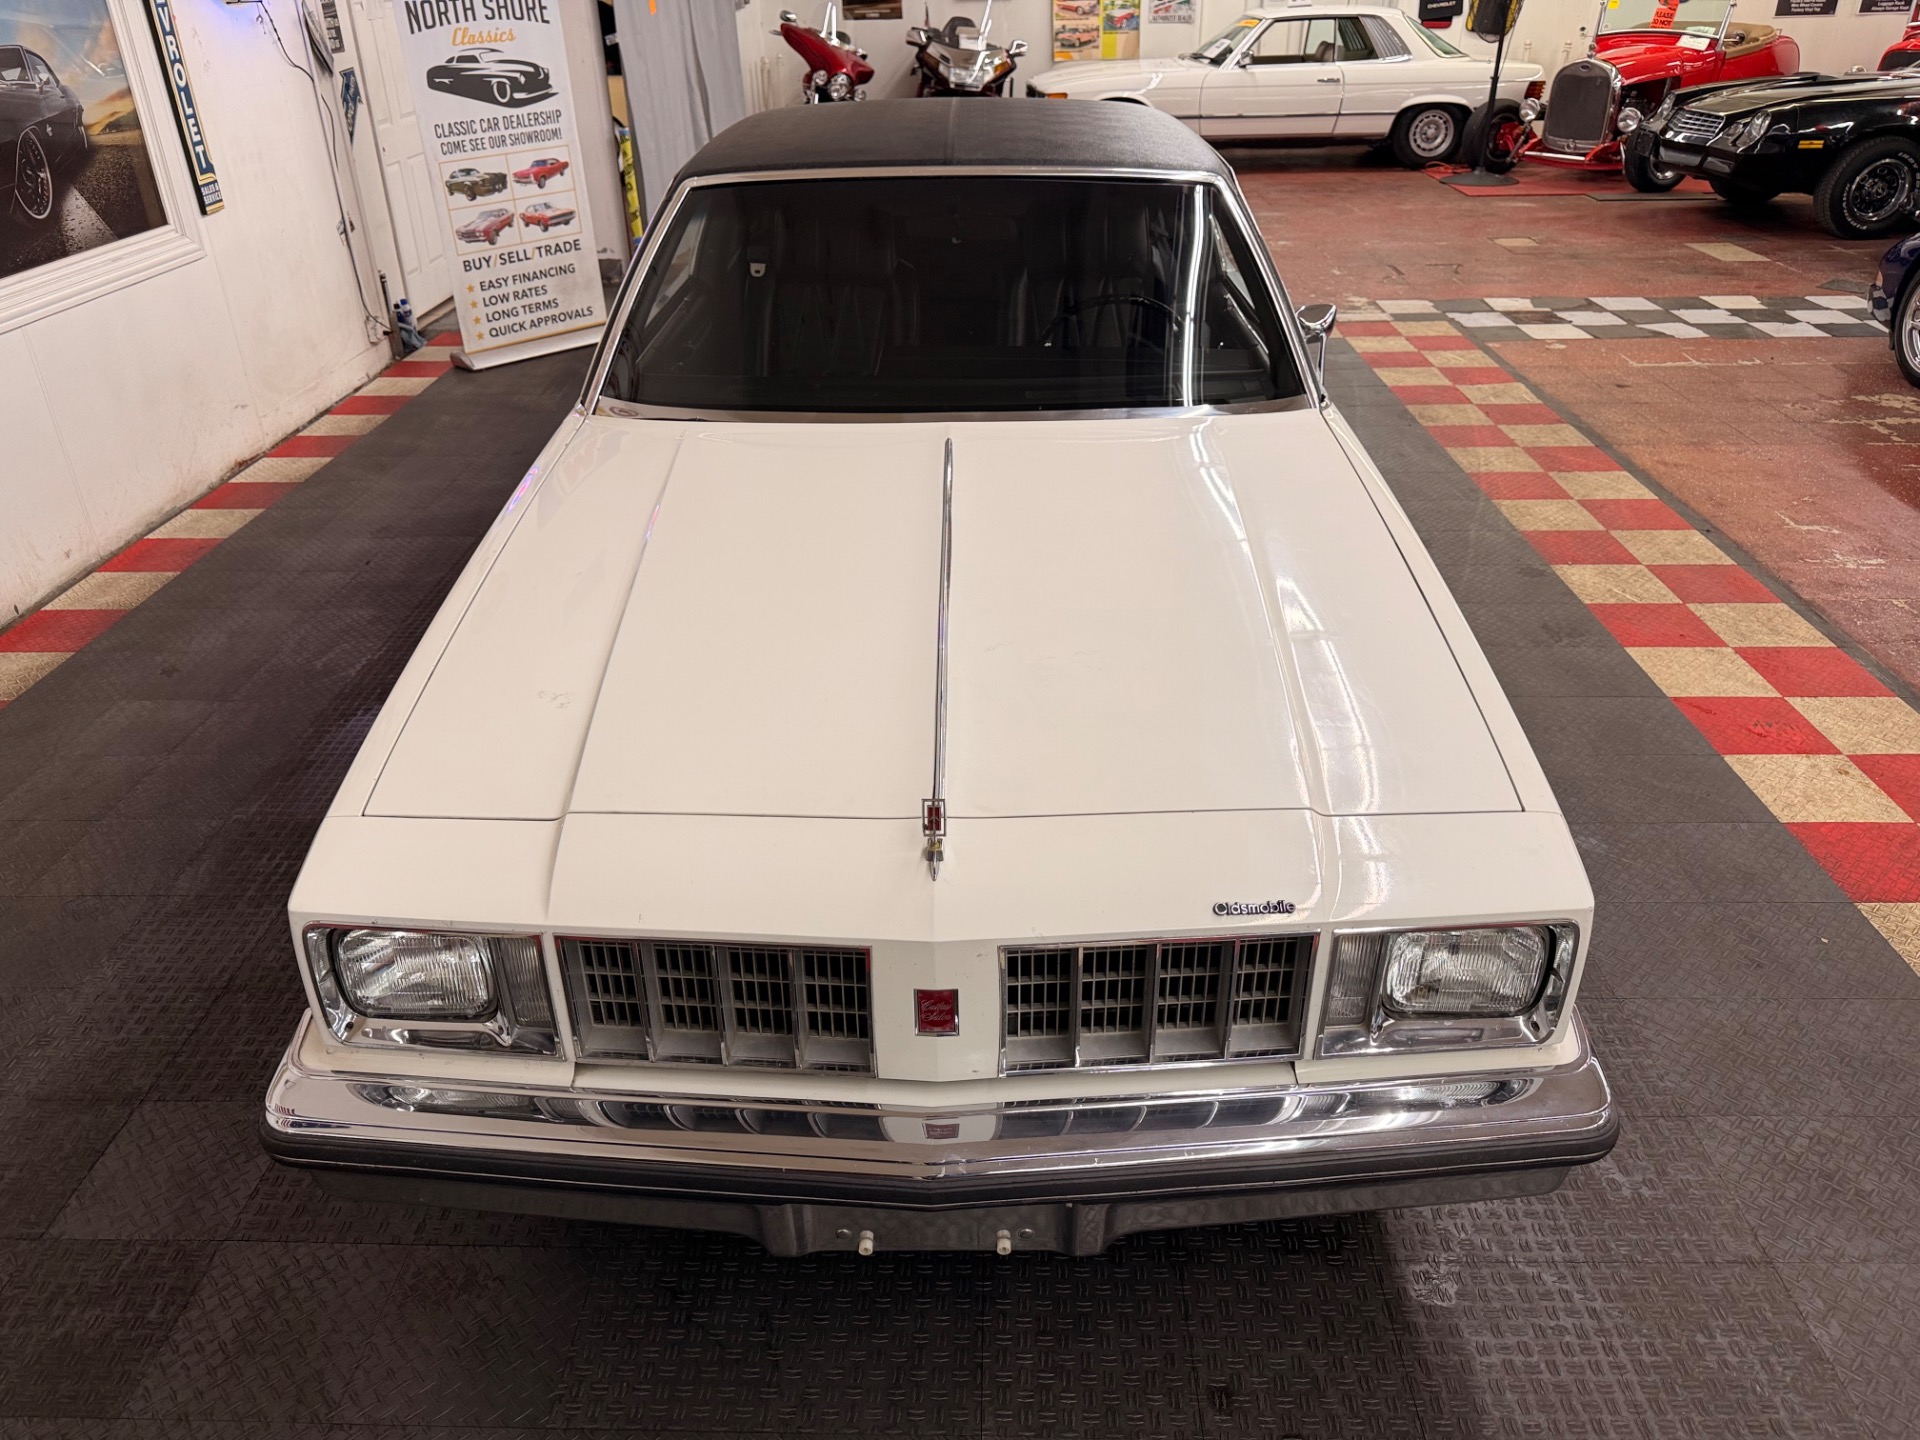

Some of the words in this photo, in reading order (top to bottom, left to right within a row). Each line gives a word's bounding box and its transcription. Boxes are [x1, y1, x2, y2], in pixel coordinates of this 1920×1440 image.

[405, 0, 477, 34] NORTH
[482, 0, 550, 24] SHORE
[451, 26, 516, 46] Classics
[434, 119, 478, 139] CLASSIC
[479, 117, 501, 133] CAR
[502, 109, 562, 130] DEALERSHIP
[440, 139, 468, 155] COME
[469, 137, 487, 152] SEE
[488, 134, 508, 149] OUR
[509, 127, 562, 147] SHOWROOM!
[479, 276, 509, 291] EASY
[512, 263, 576, 285] FINANCING
[483, 292, 510, 307] LOW
[512, 285, 547, 301] RATES
[485, 306, 519, 323] LONG
[521, 298, 559, 315] TERMS
[489, 321, 527, 338] QUICK
[529, 306, 593, 329] APPROVALS
[1213, 900, 1296, 916] Oldsmobile
